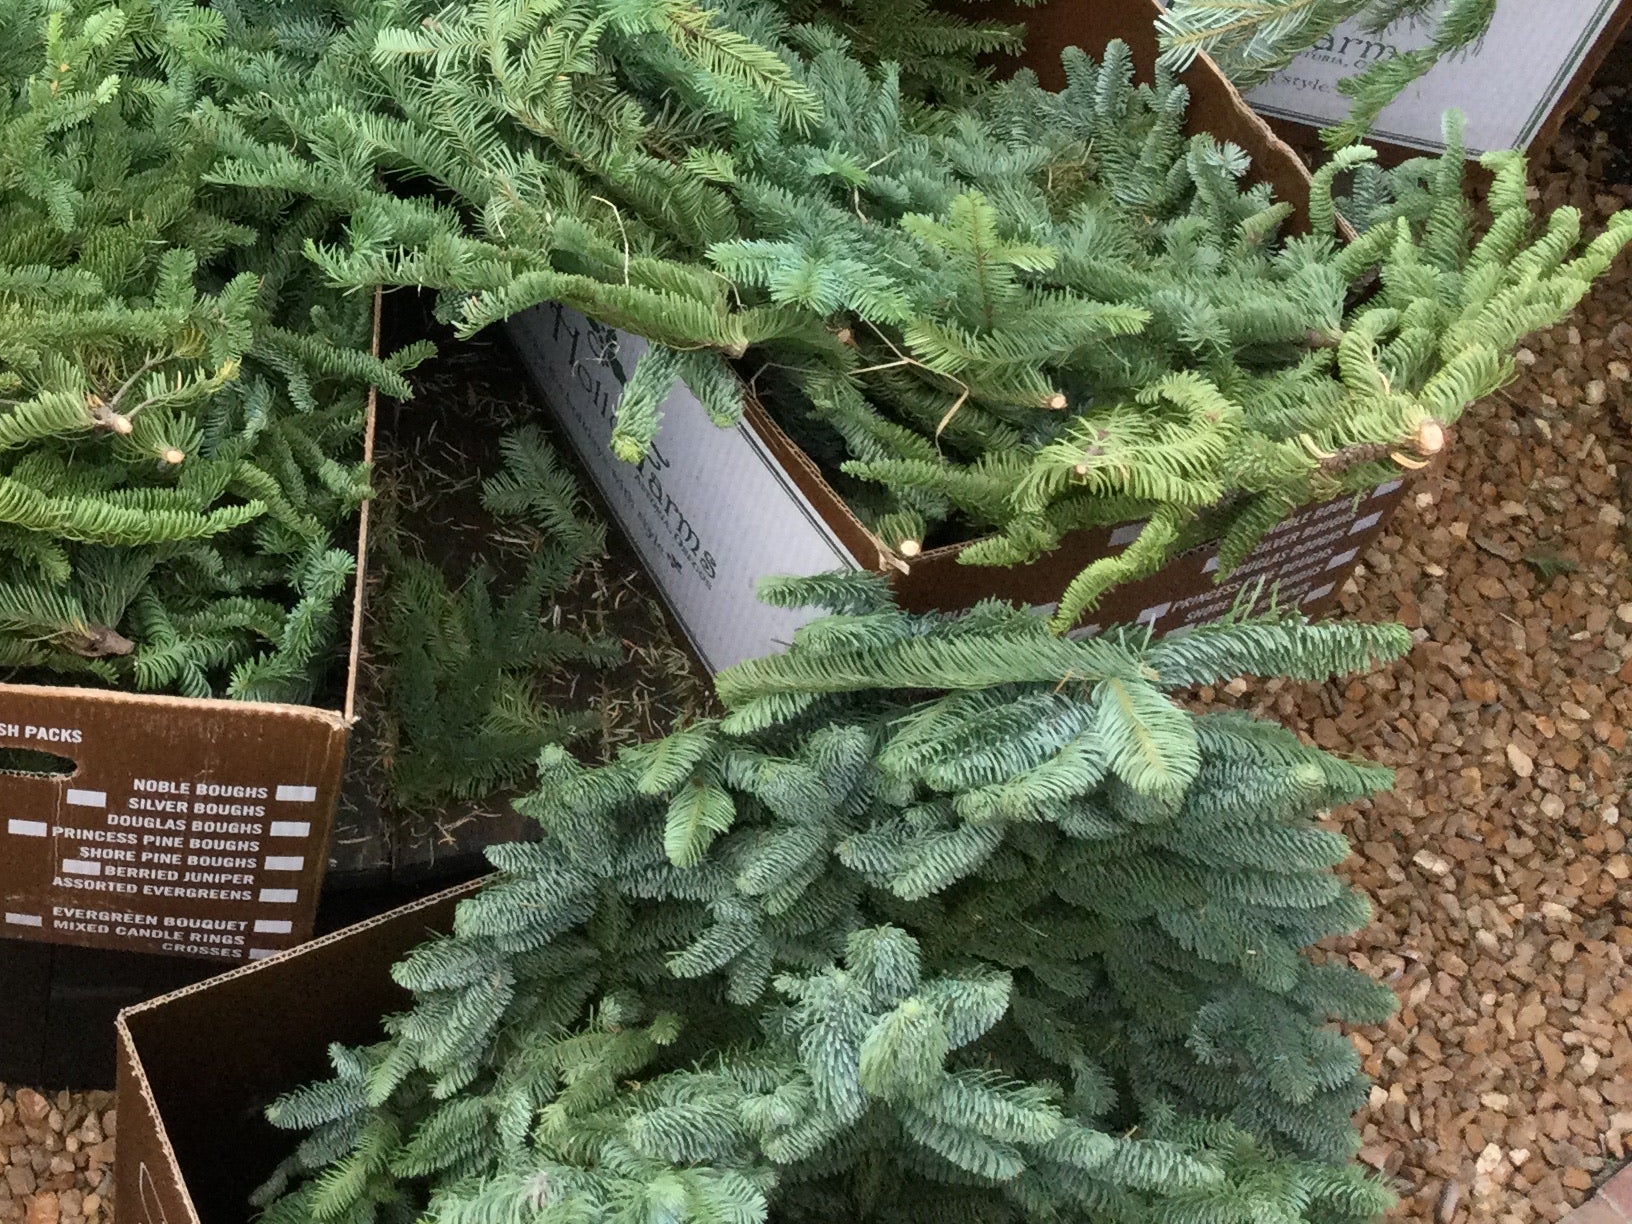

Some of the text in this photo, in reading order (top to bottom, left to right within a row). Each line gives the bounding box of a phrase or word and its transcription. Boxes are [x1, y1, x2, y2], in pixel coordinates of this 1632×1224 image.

[1312, 33, 1398, 61] arm
[24, 725, 83, 743] PACKS
[133, 778, 268, 799] NOBLE BOUGHS
[128, 797, 266, 817] SILVER BOUGHS
[107, 814, 263, 835] DOUGLAS BOUGHS
[52, 826, 260, 853] PRINCESS PINE BOUGHS
[79, 846, 257, 869] SHORE PINE BOUGHS
[104, 865, 255, 886] BERRIED JUNIPER
[52, 876, 252, 901] ASSORTED EVERGREENS
[52, 906, 248, 932] EVERGREEN BOUQUET
[53, 919, 245, 946] MIXED CANDLE RINGS
[162, 942, 243, 958] CROSSES
